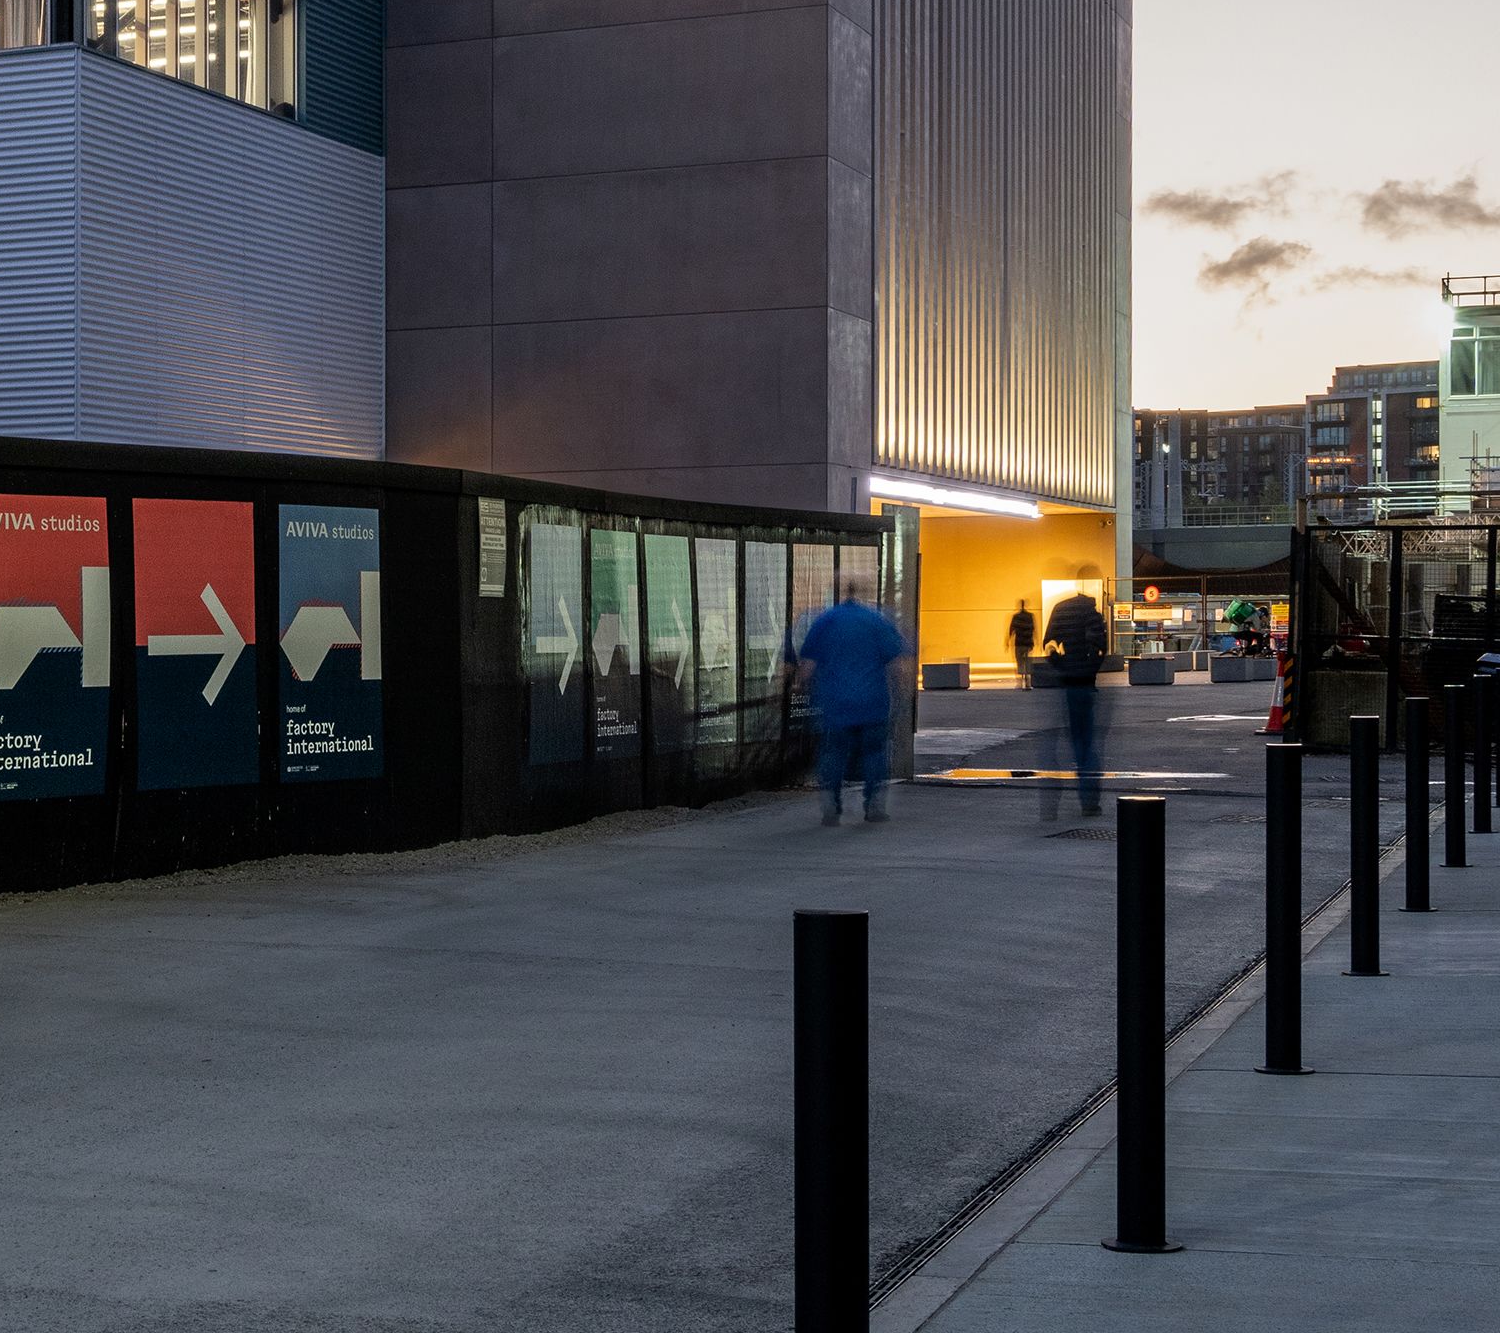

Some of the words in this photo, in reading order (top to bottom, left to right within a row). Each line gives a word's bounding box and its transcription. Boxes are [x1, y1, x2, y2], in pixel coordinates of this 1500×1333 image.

[40, 514, 100, 532] studios
[286, 521, 329, 538] AVIVA
[332, 524, 374, 540] studios
[286, 719, 335, 737] factory
[286, 735, 374, 755] international
